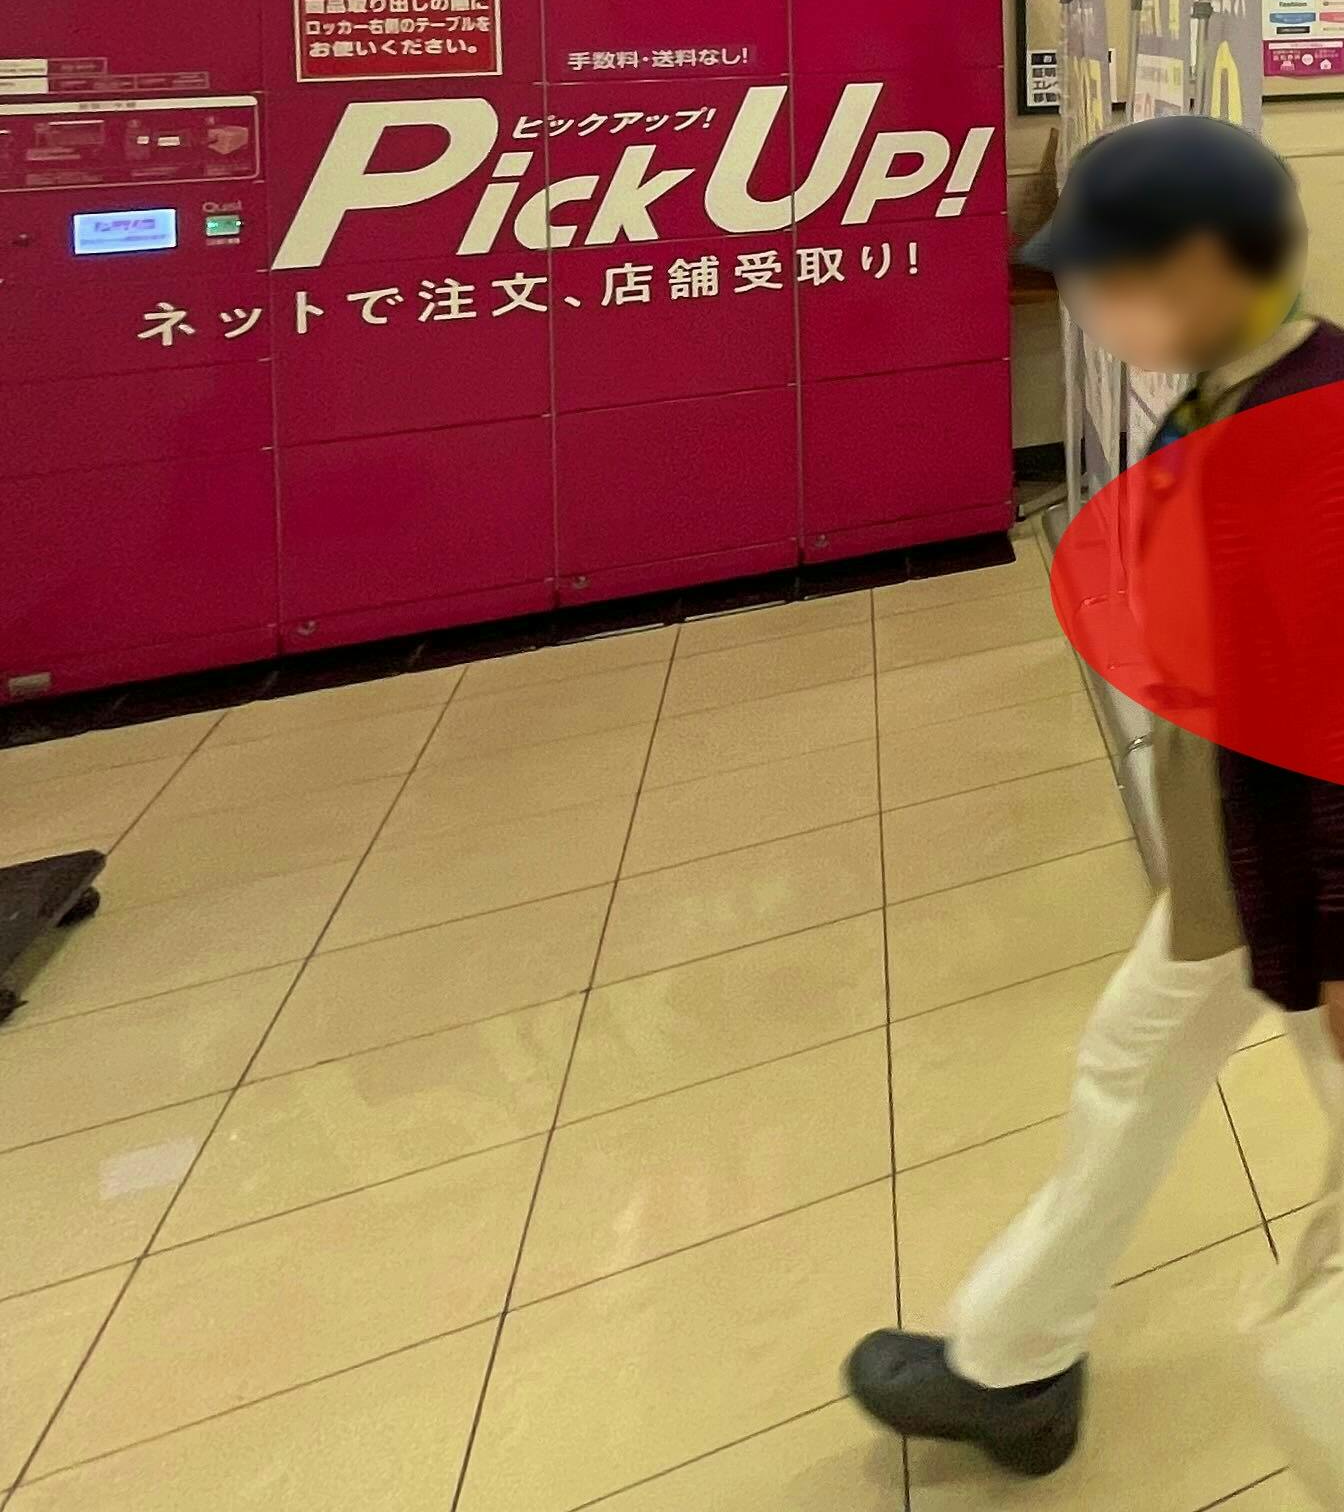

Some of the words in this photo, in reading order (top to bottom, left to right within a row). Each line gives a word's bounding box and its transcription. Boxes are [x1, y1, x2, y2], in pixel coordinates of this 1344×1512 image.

[512, 106, 717, 139] ピックアップ!
[271, 97, 696, 272] Pick
[137, 241, 920, 346] ネットで注文、店舗受取り!
